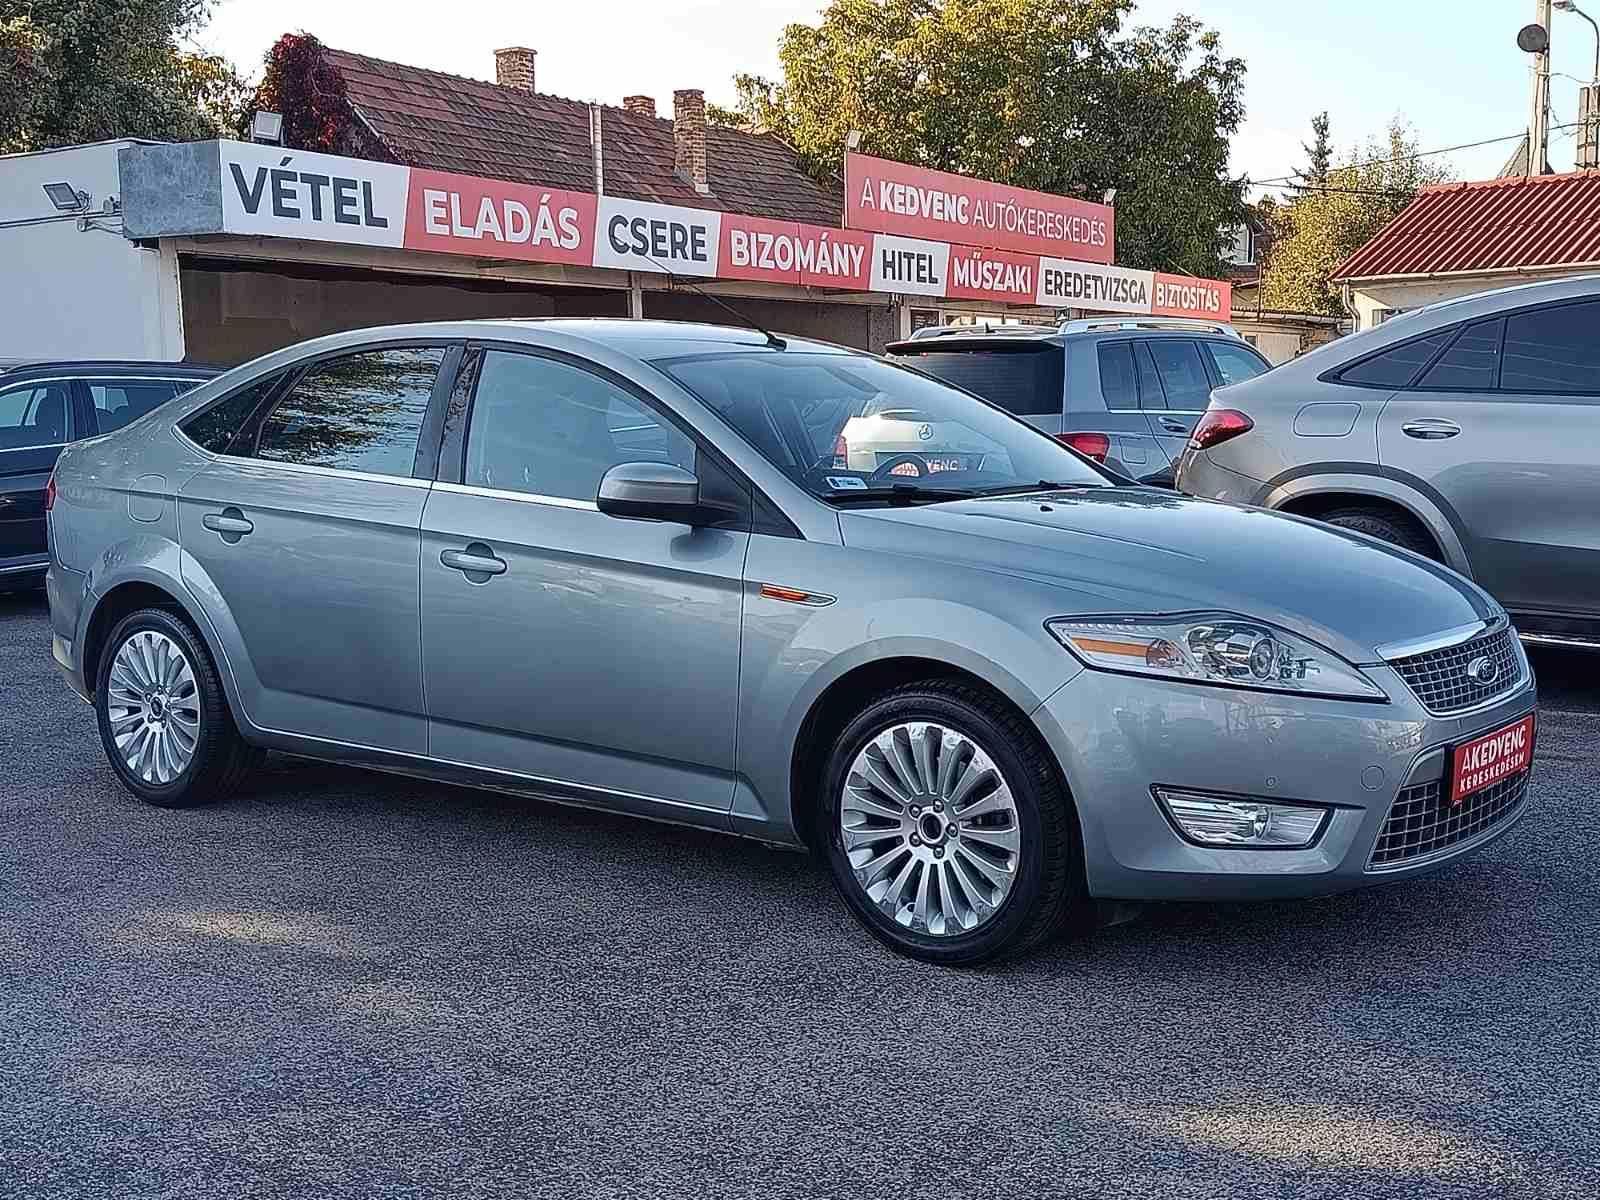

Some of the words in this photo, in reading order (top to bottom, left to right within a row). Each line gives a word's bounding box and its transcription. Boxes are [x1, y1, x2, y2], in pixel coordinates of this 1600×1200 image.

[230, 157, 388, 229] VÉTEL
[860, 178, 876, 209] A
[879, 180, 969, 225] KEDVENC
[972, 198, 1106, 247] AUTÓKERESKEDÉS
[424, 189, 581, 250] ELADÁS
[608, 214, 708, 262] CSERE
[731, 229, 865, 277] BIZOMÁNY
[882, 248, 939, 285] HITEL
[953, 249, 1032, 294] MŰSZAKI
[1044, 269, 1147, 305] EREDETVIZSGA
[1156, 281, 1221, 312] BIZTOSÍTÁS
